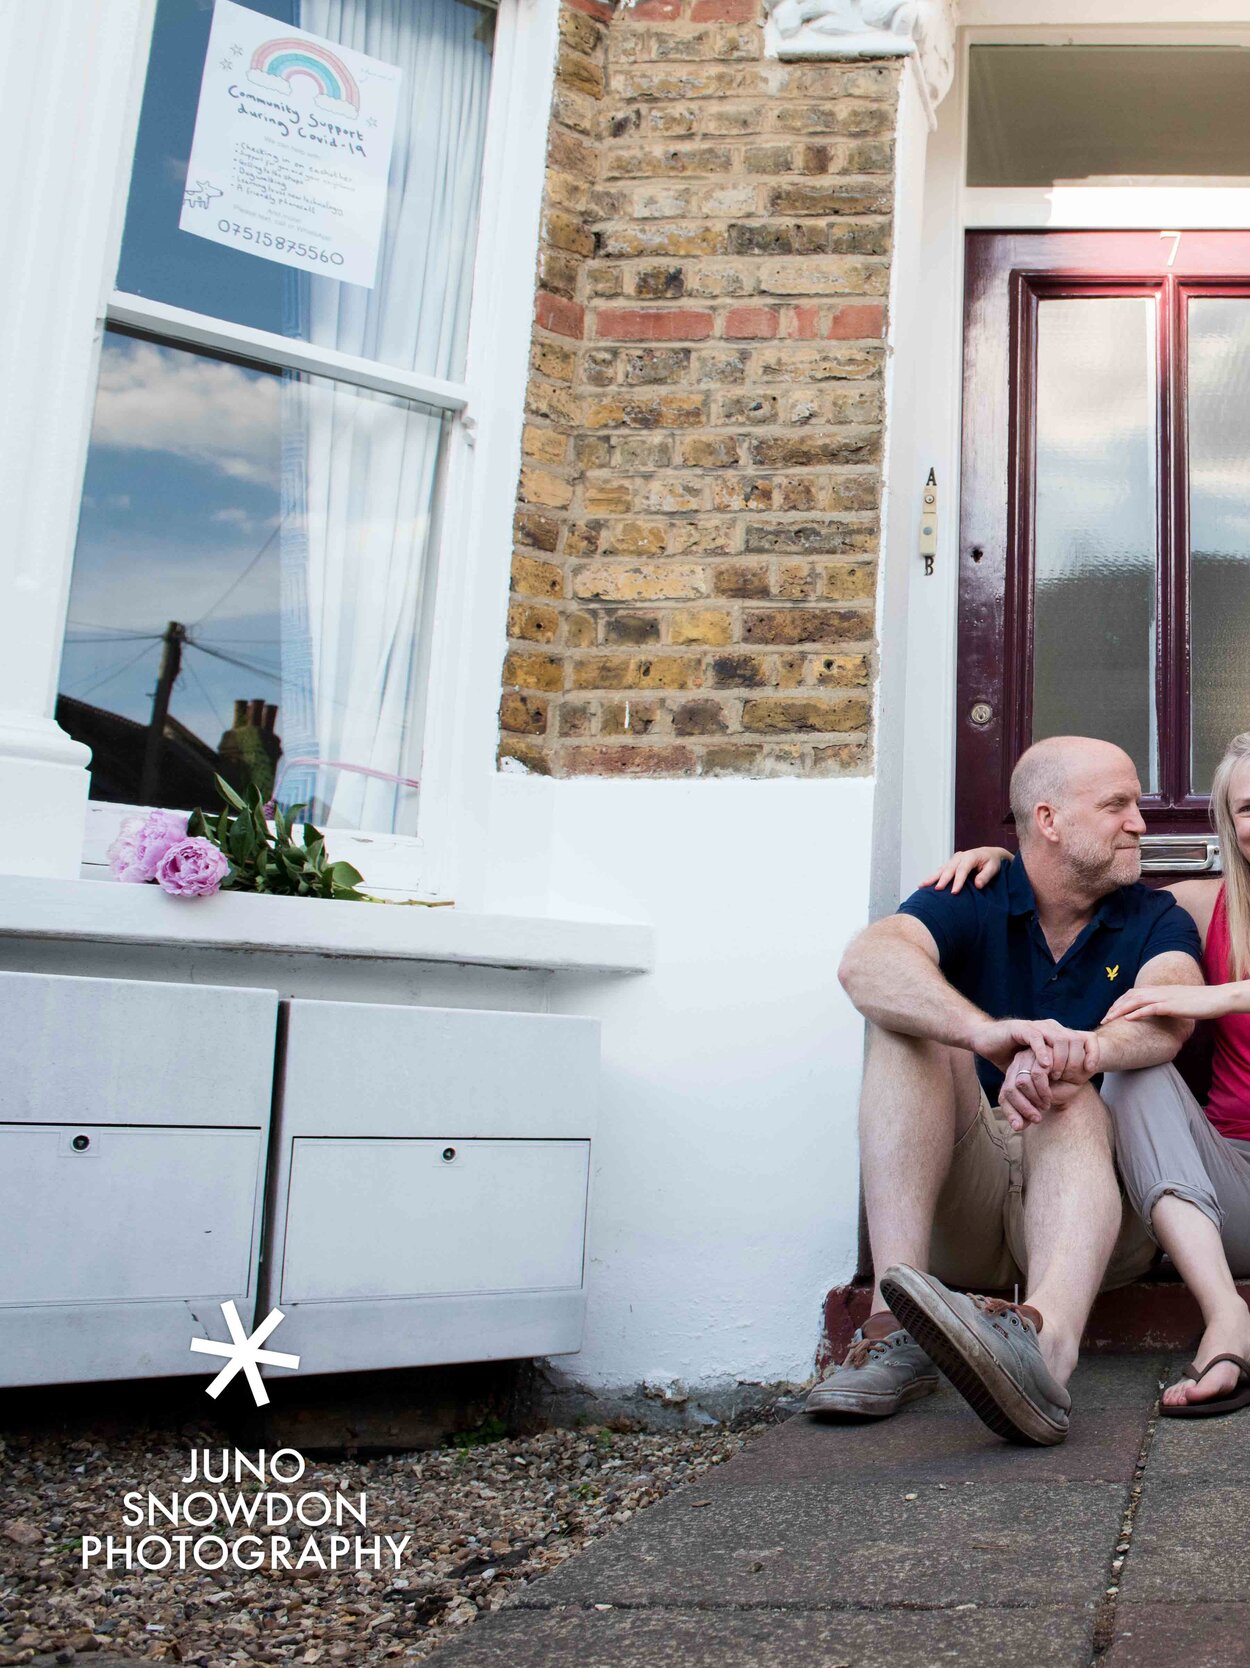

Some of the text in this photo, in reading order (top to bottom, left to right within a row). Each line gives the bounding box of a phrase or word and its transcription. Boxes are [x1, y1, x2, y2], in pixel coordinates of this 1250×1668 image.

[228, 85, 364, 141] Community Support
[237, 103, 367, 158] during Covid-19
[241, 142, 279, 163] Checking
[295, 161, 304, 169] on
[236, 184, 243, 193] A
[246, 187, 276, 205] friendly
[217, 219, 345, 265] 07515875560
[1160, 231, 1181, 267] 7
[926, 466, 937, 486] A
[924, 556, 935, 576] B
